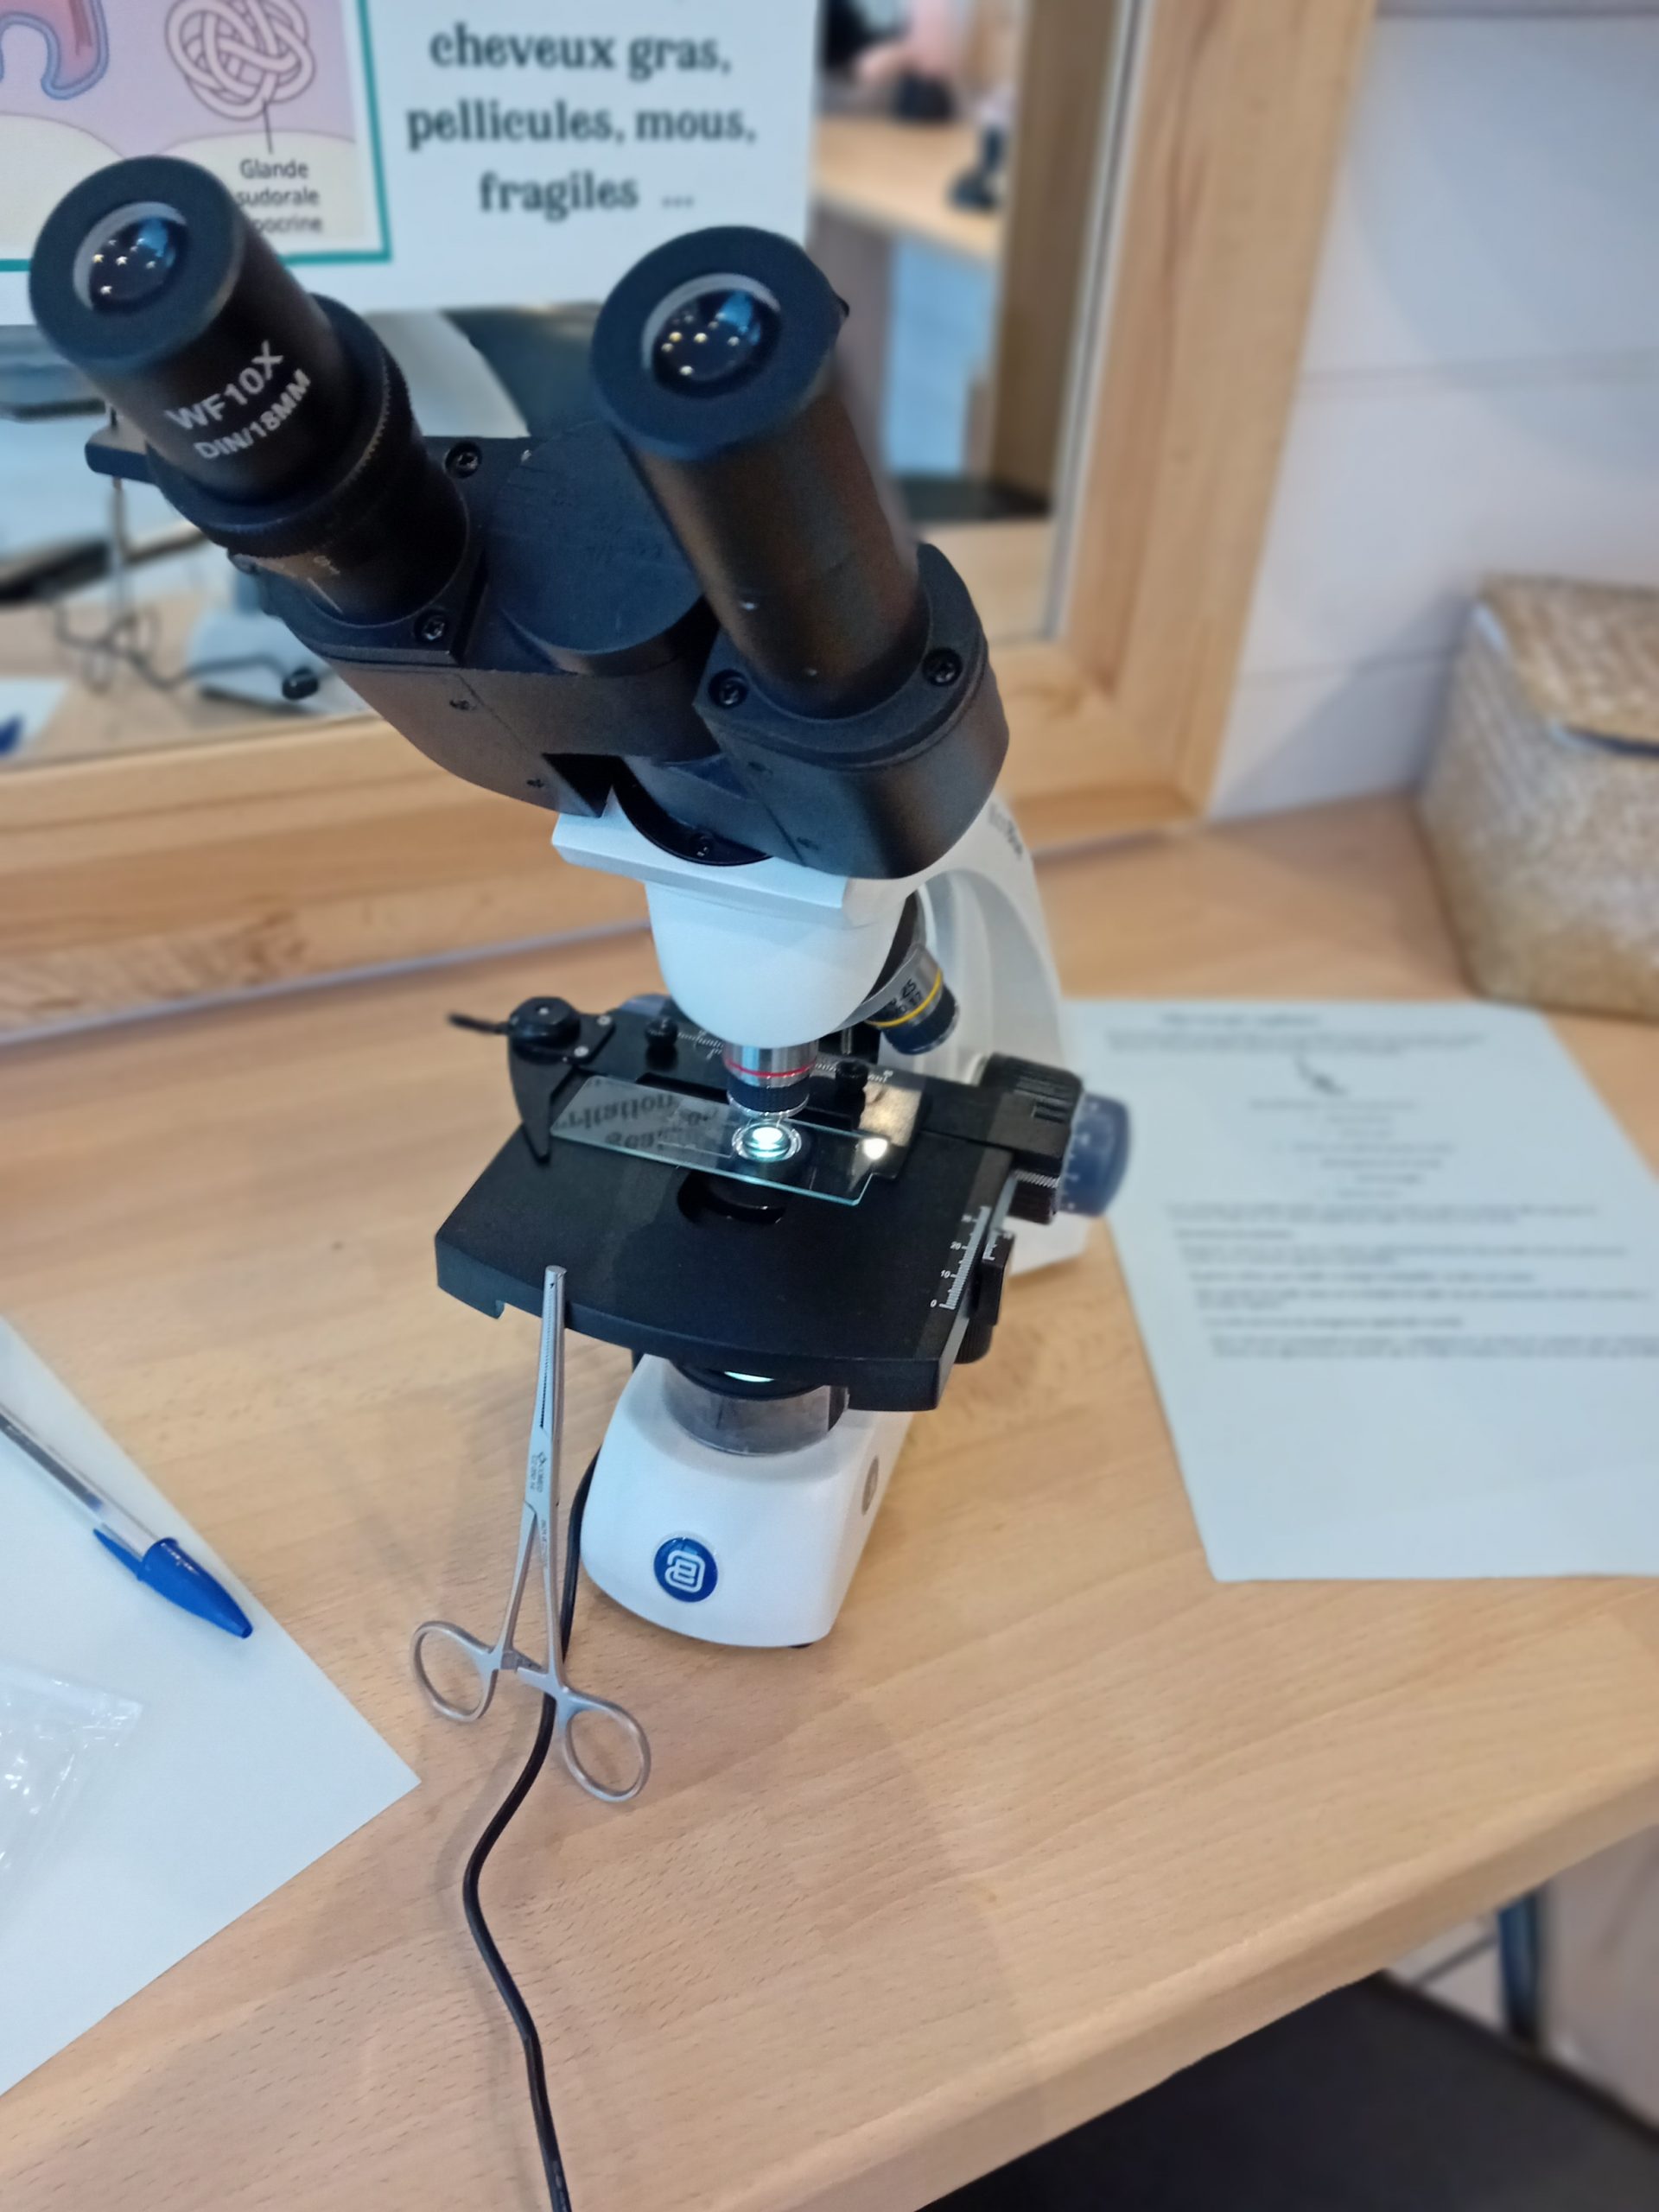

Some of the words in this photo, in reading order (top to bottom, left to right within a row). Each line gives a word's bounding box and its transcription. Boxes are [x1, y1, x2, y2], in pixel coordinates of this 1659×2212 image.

[429, 22, 614, 69] cheveux
[628, 36, 731, 83] gras,
[406, 99, 625, 153] pellicules,
[635, 108, 756, 144] mous,
[239, 159, 309, 179] Glande
[237, 187, 320, 207] sudorale
[480, 172, 639, 223] fragiles
[253, 215, 323, 234] pocrine
[163, 340, 284, 430] WF10X
[193, 368, 311, 460] DIN/18MM
[940, 1269, 951, 1279] 10
